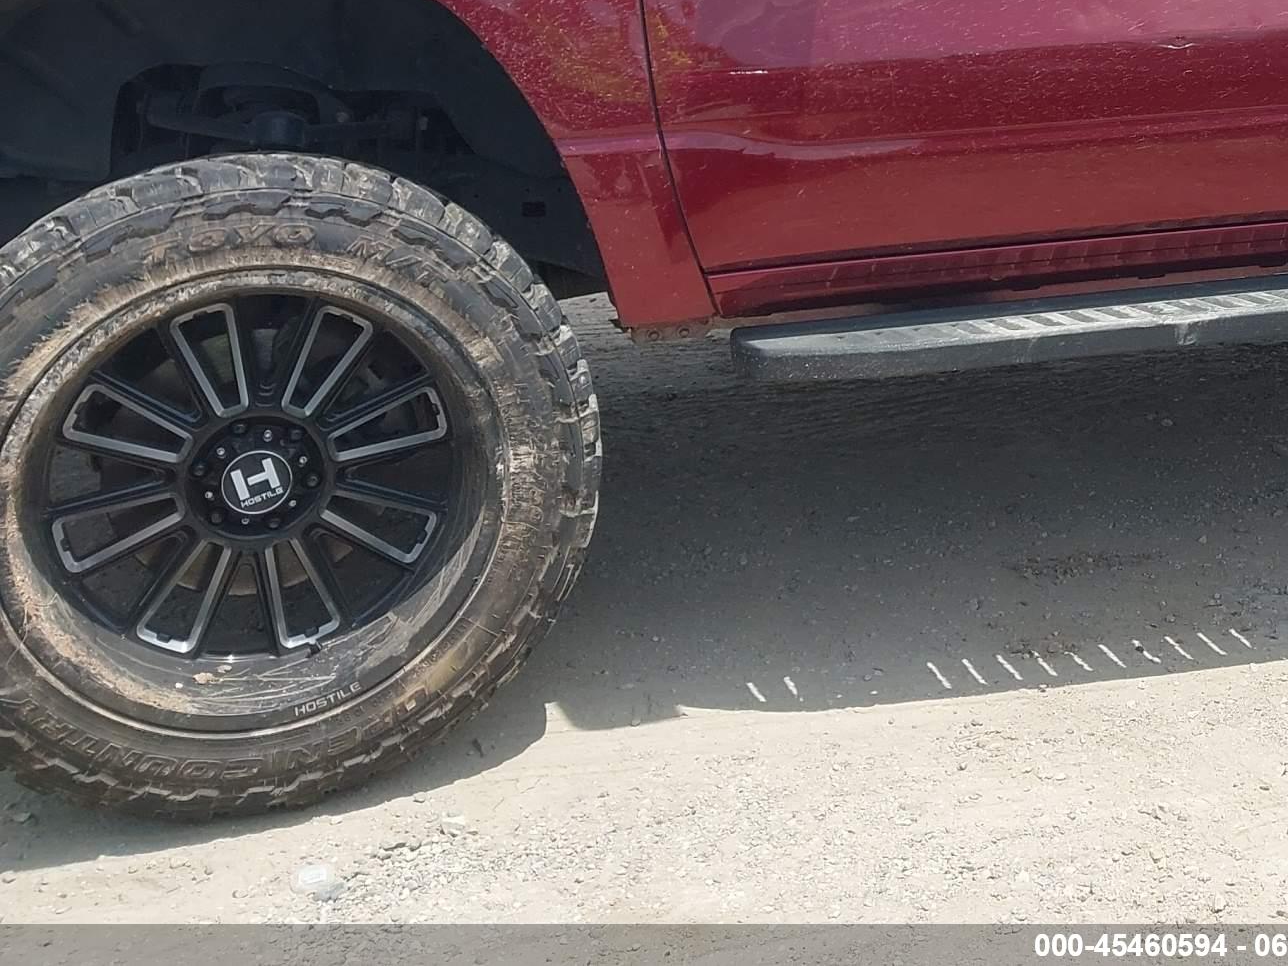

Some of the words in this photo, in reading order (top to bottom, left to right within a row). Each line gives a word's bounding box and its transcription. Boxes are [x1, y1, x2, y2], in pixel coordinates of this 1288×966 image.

[230, 458, 280, 501] H
[240, 487, 284, 508] HOSTILE
[293, 681, 362, 717] HOSTILE
